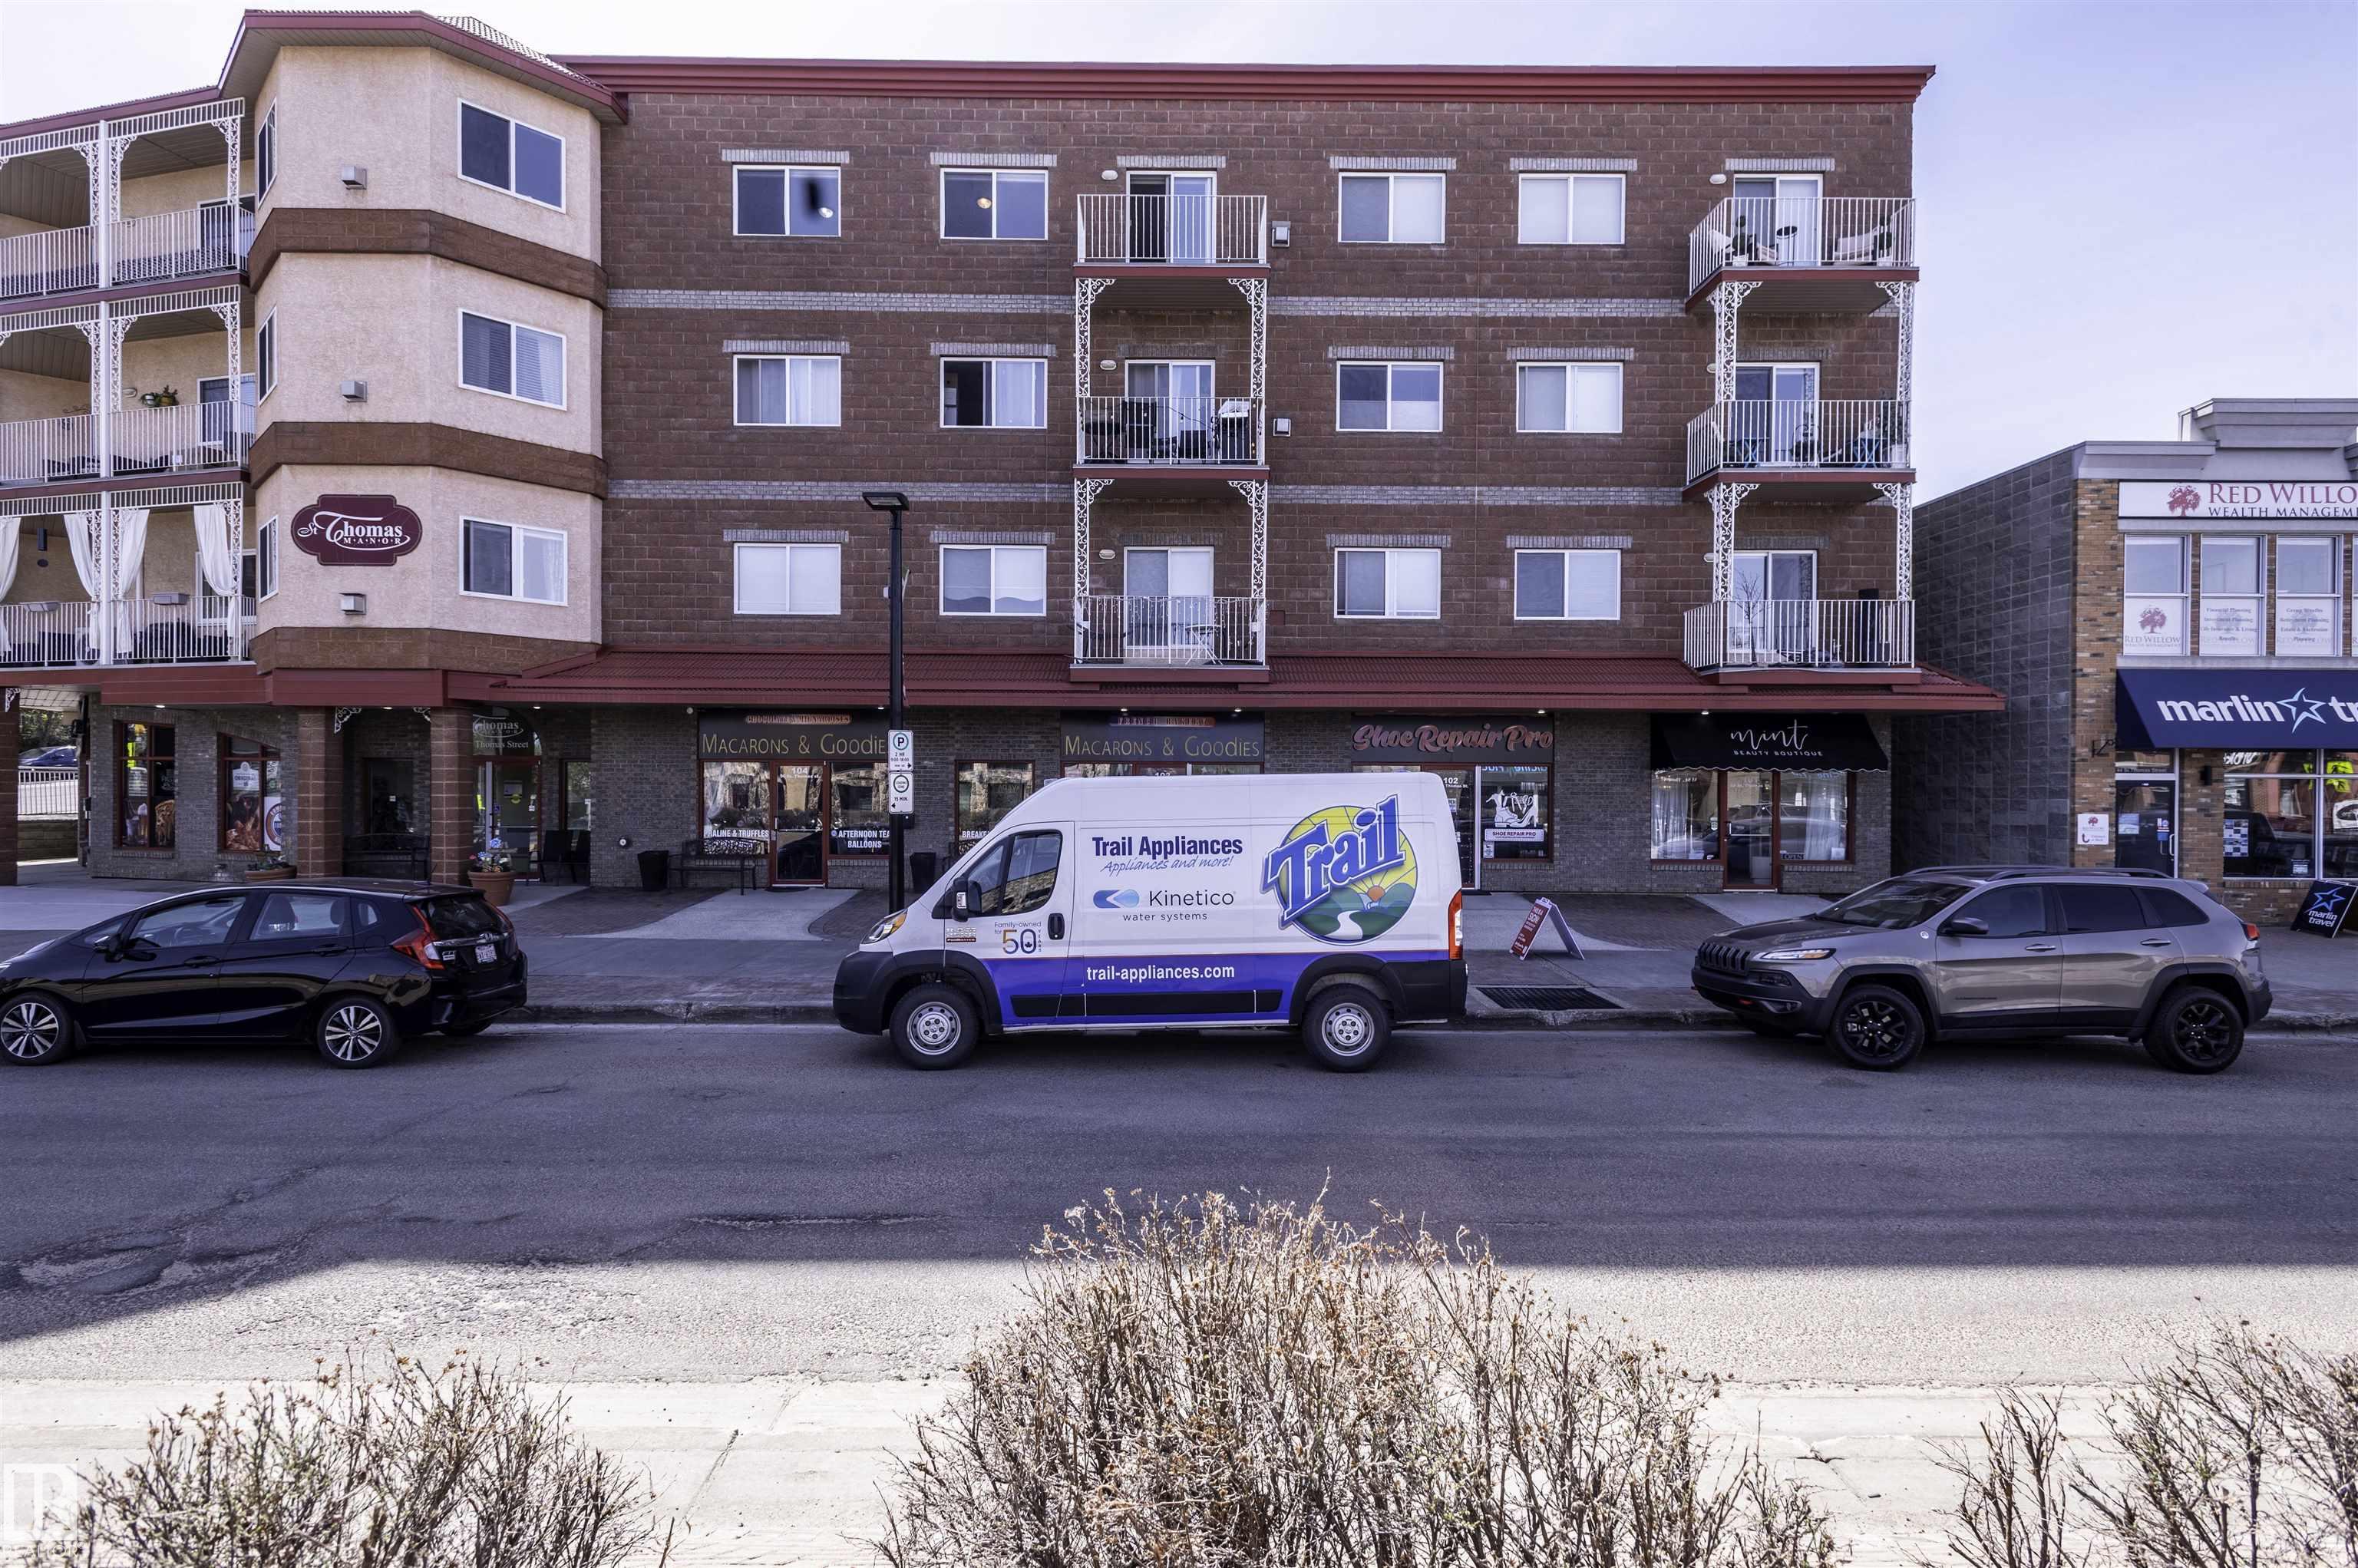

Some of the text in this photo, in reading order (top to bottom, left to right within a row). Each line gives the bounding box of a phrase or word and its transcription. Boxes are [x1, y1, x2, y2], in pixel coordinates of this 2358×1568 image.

[2209, 483, 2262, 504] RED
[2208, 507, 2358, 517] WEALTH MANAGEM
[296, 522, 319, 538] St
[313, 511, 405, 546] Thomas
[2156, 695, 2285, 722] marlin
[897, 737, 905, 747] P
[1353, 723, 1554, 752] Shoe Repair Pro
[1730, 719, 1808, 750] mint
[475, 741, 529, 749] Thomas Street
[798, 734, 811, 754] &
[1162, 737, 1174, 757] &
[738, 829, 769, 838] TRUFFLES
[838, 830, 877, 838] AFTERNOON
[1091, 835, 1243, 860] Trail Appliances
[1100, 855, 1234, 877] Appliances and more!
[1267, 794, 1406, 926] Trail
[1149, 889, 1235, 906] Kinetico
[1161, 912, 1207, 923] systems
[2308, 910, 2338, 920] marlin
[2308, 916, 2336, 927] travel
[1002, 929, 1037, 955] 50
[1087, 965, 1235, 982] trail-appliances.com
